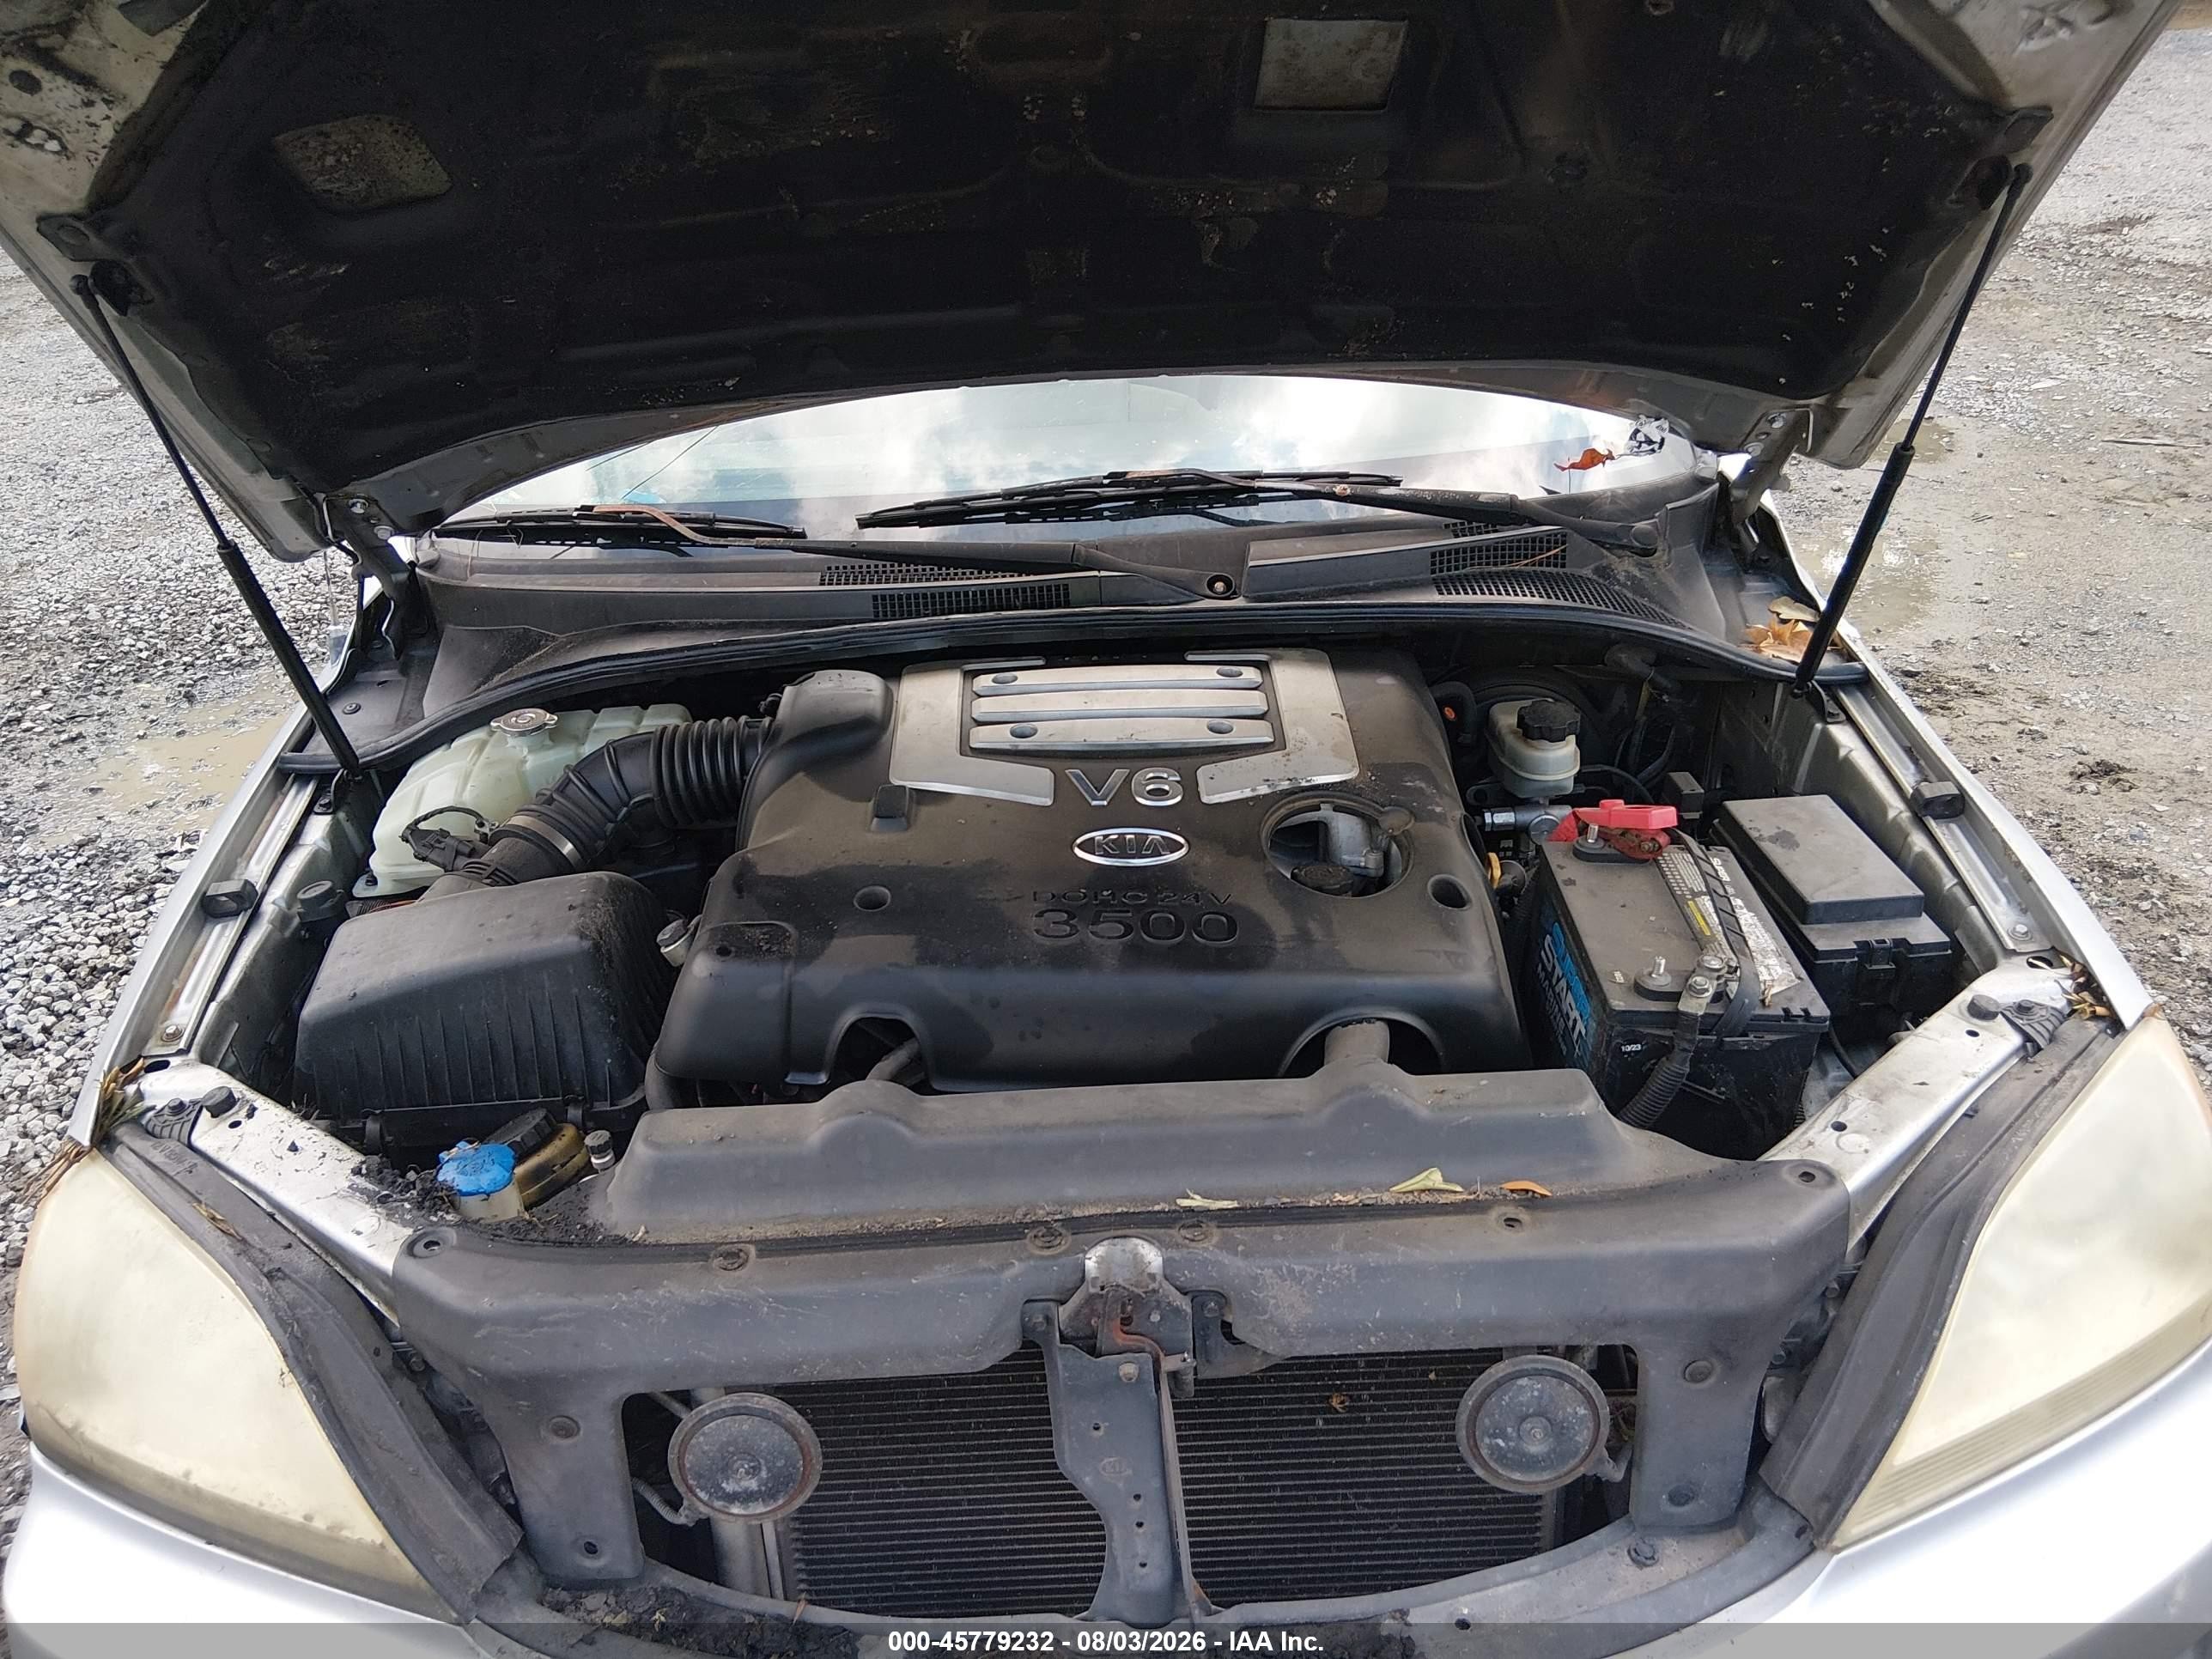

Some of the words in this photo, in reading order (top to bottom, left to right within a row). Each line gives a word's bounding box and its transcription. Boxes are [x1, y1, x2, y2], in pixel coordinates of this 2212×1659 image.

[1065, 767, 1183, 806] V6
[1093, 834, 1170, 855] KIA
[1033, 908, 1238, 944] 3500
[1541, 934, 1586, 1042] START
